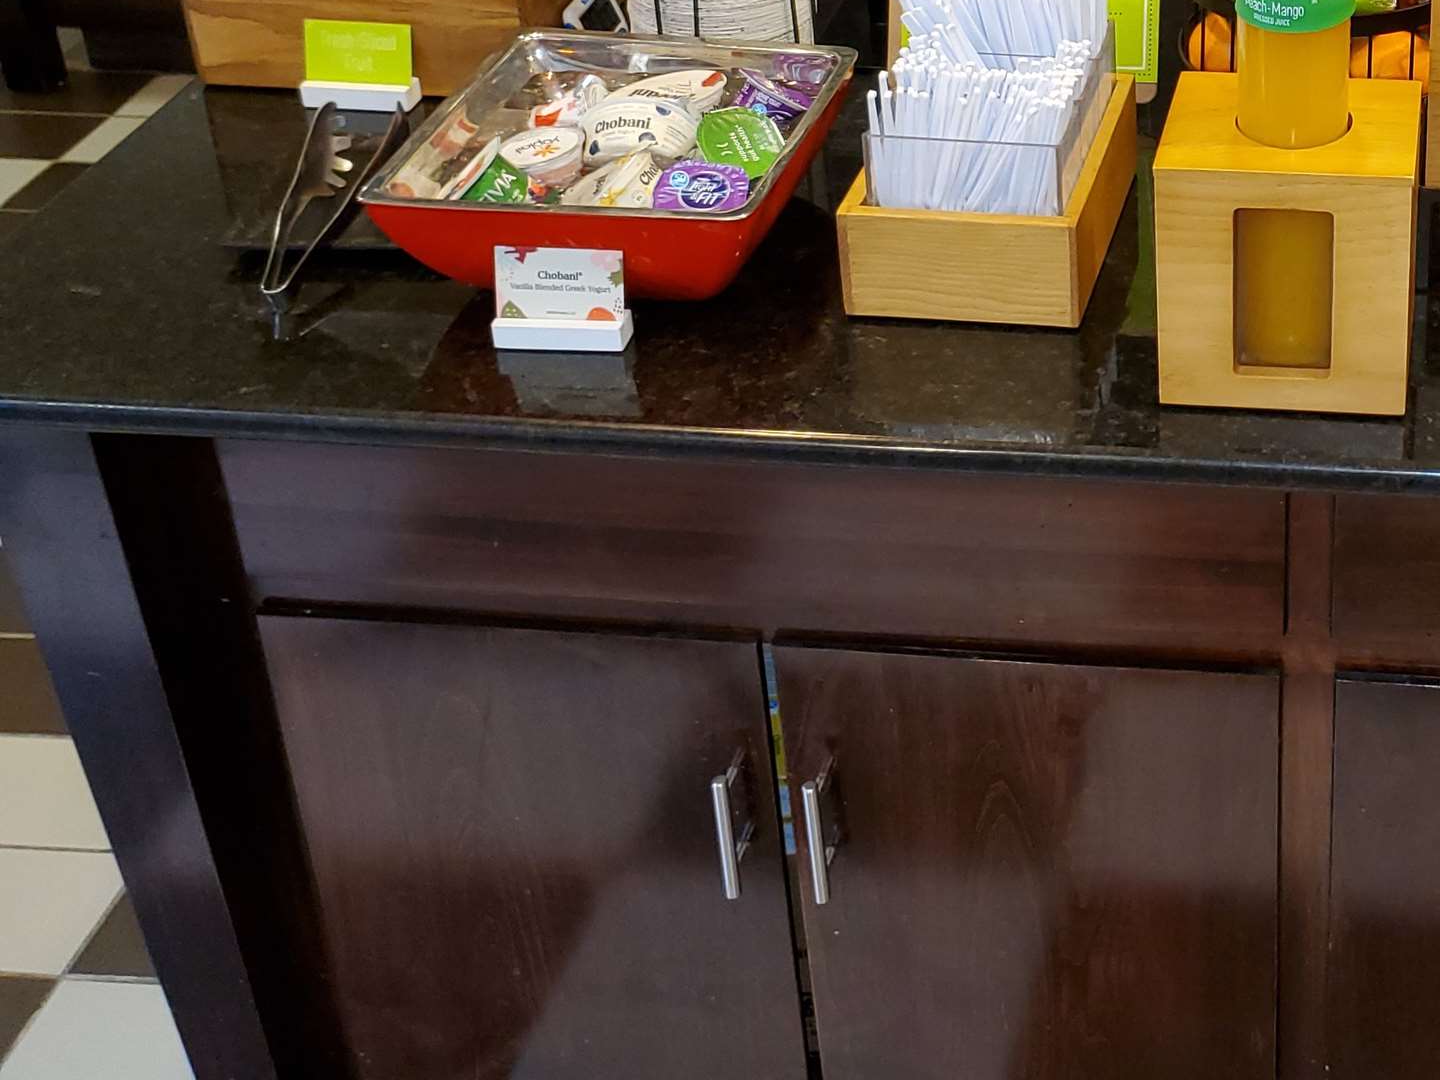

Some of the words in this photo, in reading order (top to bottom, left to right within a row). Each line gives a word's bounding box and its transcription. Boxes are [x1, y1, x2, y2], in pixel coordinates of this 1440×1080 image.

[595, 117, 652, 134] Chobani
[510, 282, 533, 291] Vanilla
[535, 283, 565, 292] Blended
